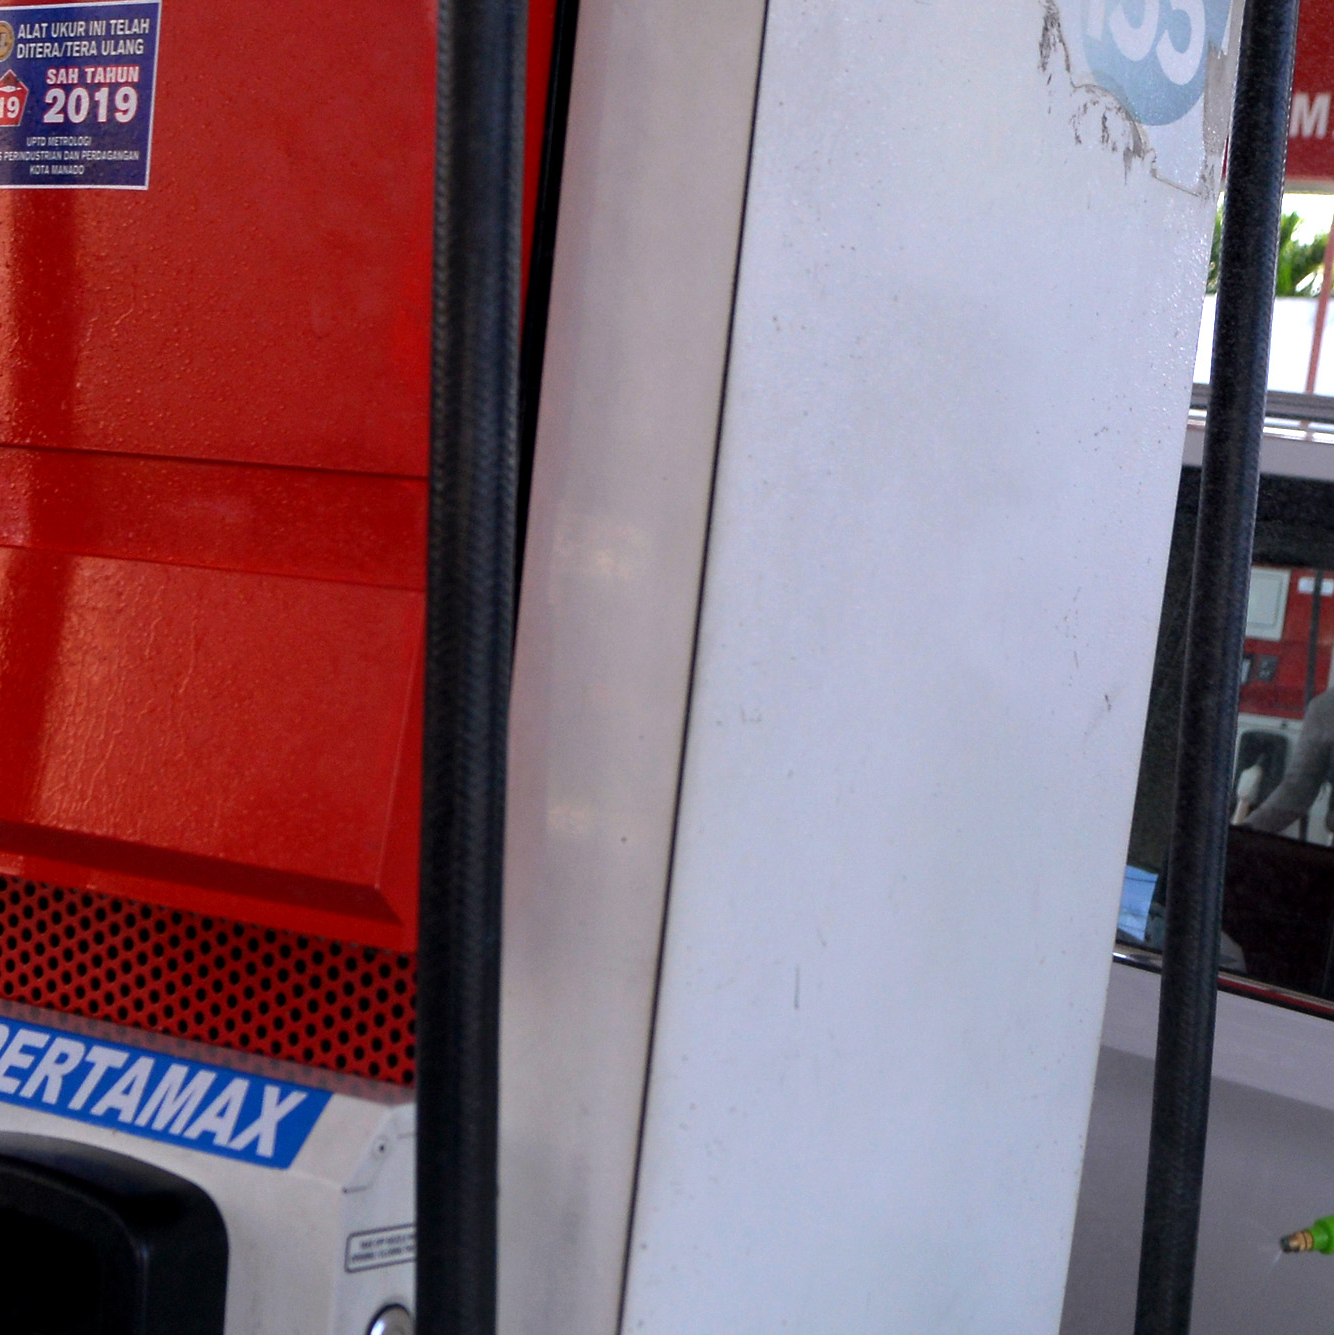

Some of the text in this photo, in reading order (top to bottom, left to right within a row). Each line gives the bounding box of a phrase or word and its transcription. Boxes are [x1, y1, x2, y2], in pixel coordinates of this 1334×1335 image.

[17, 18, 150, 39] ALAT UKUR INI TELAH
[17, 39, 144, 59] DITERA/TERA ULANG
[46, 66, 140, 84] SAH TAHUN
[43, 86, 138, 124] 2019
[26, 136, 92, 147] UPTD METROLOGI
[3, 151, 62, 161] PERINDUSTRIAN
[64, 151, 80, 161] DAN
[82, 150, 139, 161] PERDAGANGAN
[29, 164, 85, 175] KOTA MANADO
